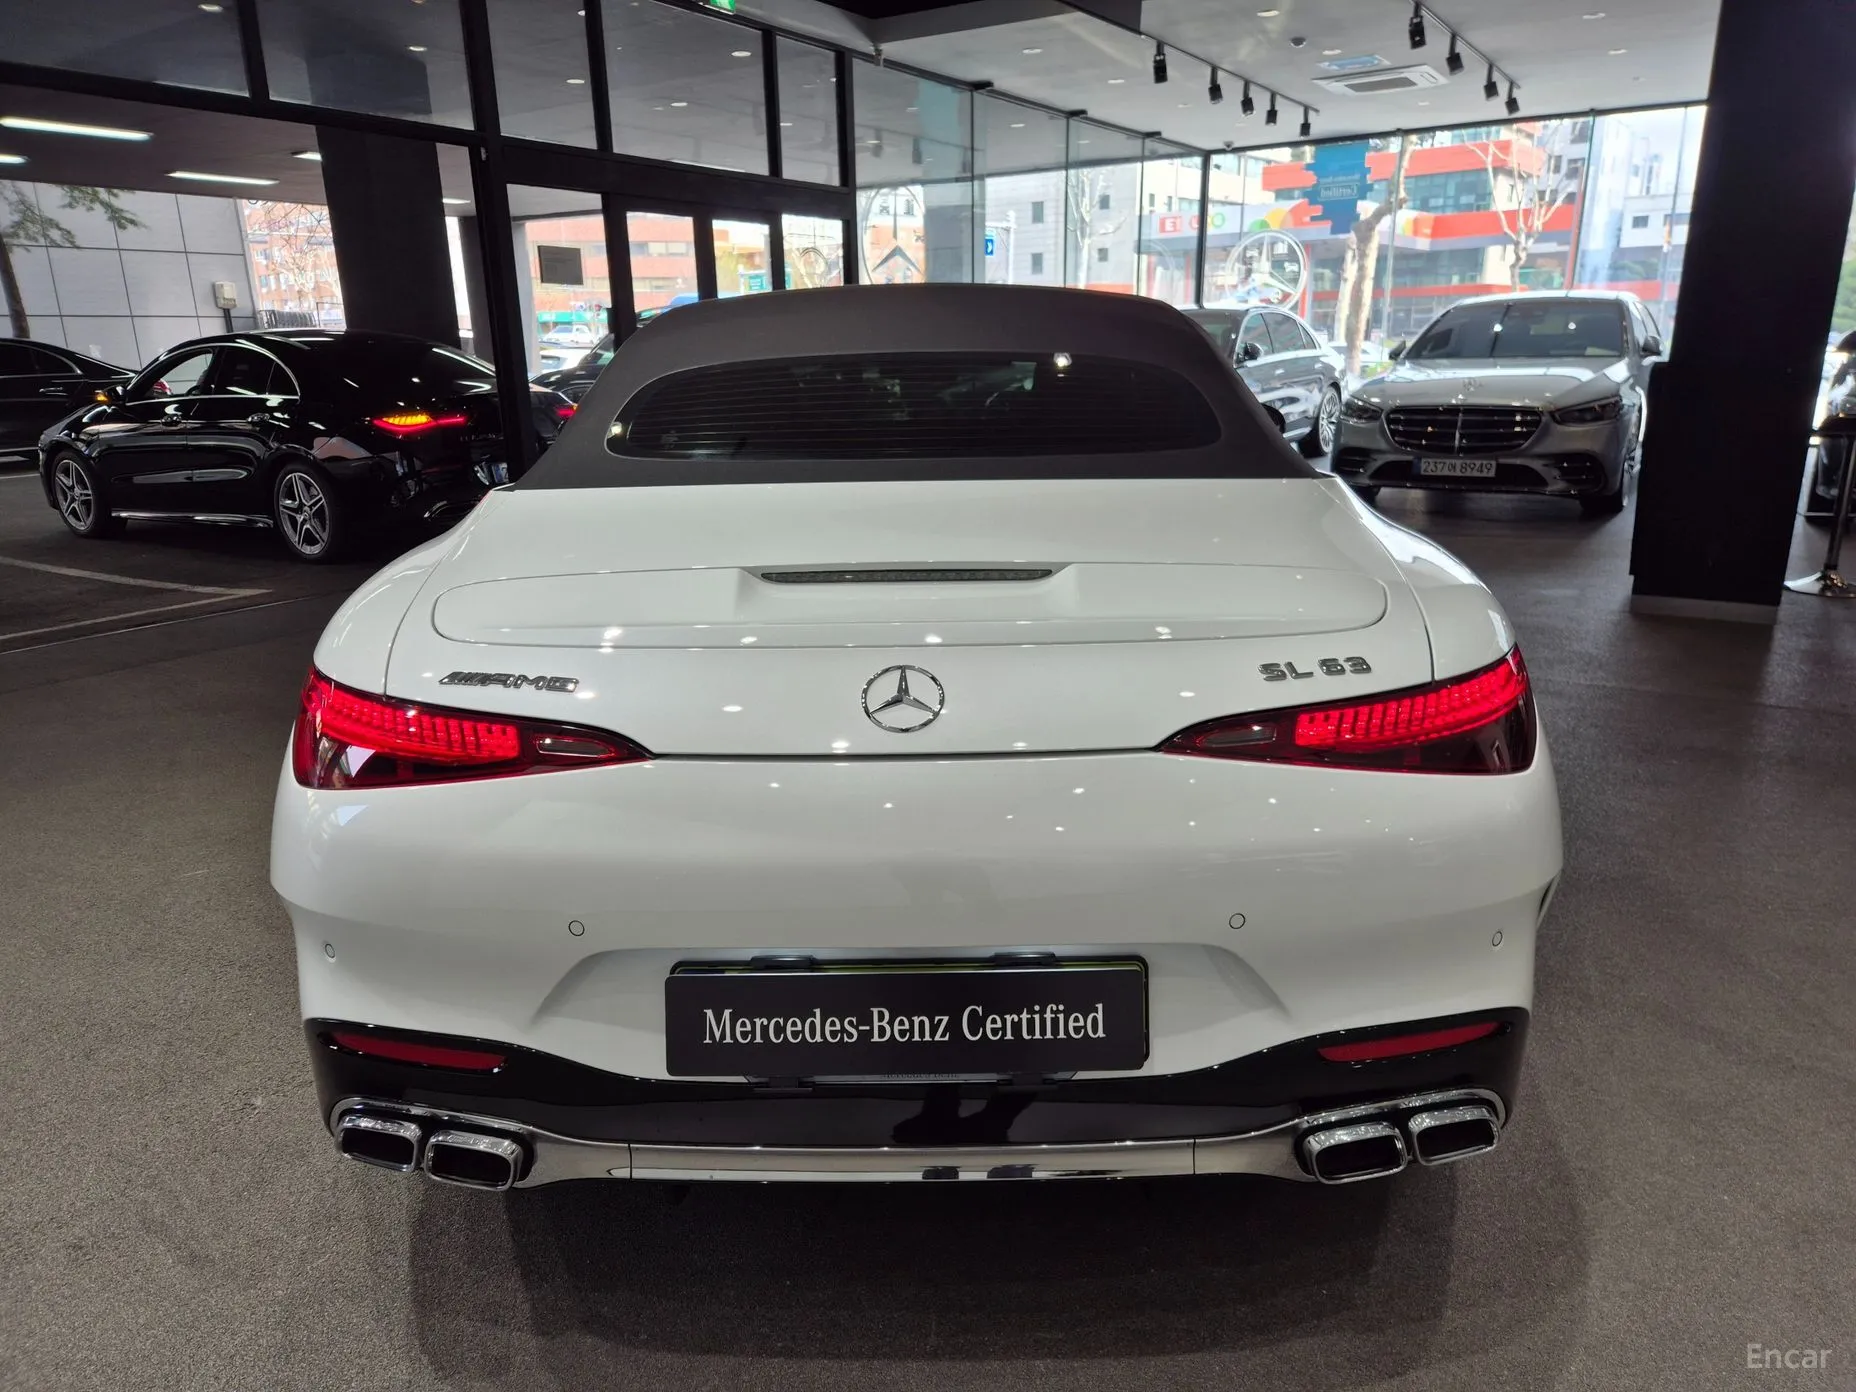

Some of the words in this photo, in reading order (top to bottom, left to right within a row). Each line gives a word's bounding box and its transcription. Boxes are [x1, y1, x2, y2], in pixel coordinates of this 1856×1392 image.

[1459, 461, 1493, 475] 8949
[1258, 661, 1314, 682] SL
[1317, 656, 1372, 676] 63
[438, 671, 579, 693] AMG
[703, 1007, 951, 1045] Mercedes-Benz
[961, 1003, 1107, 1041] Certified
